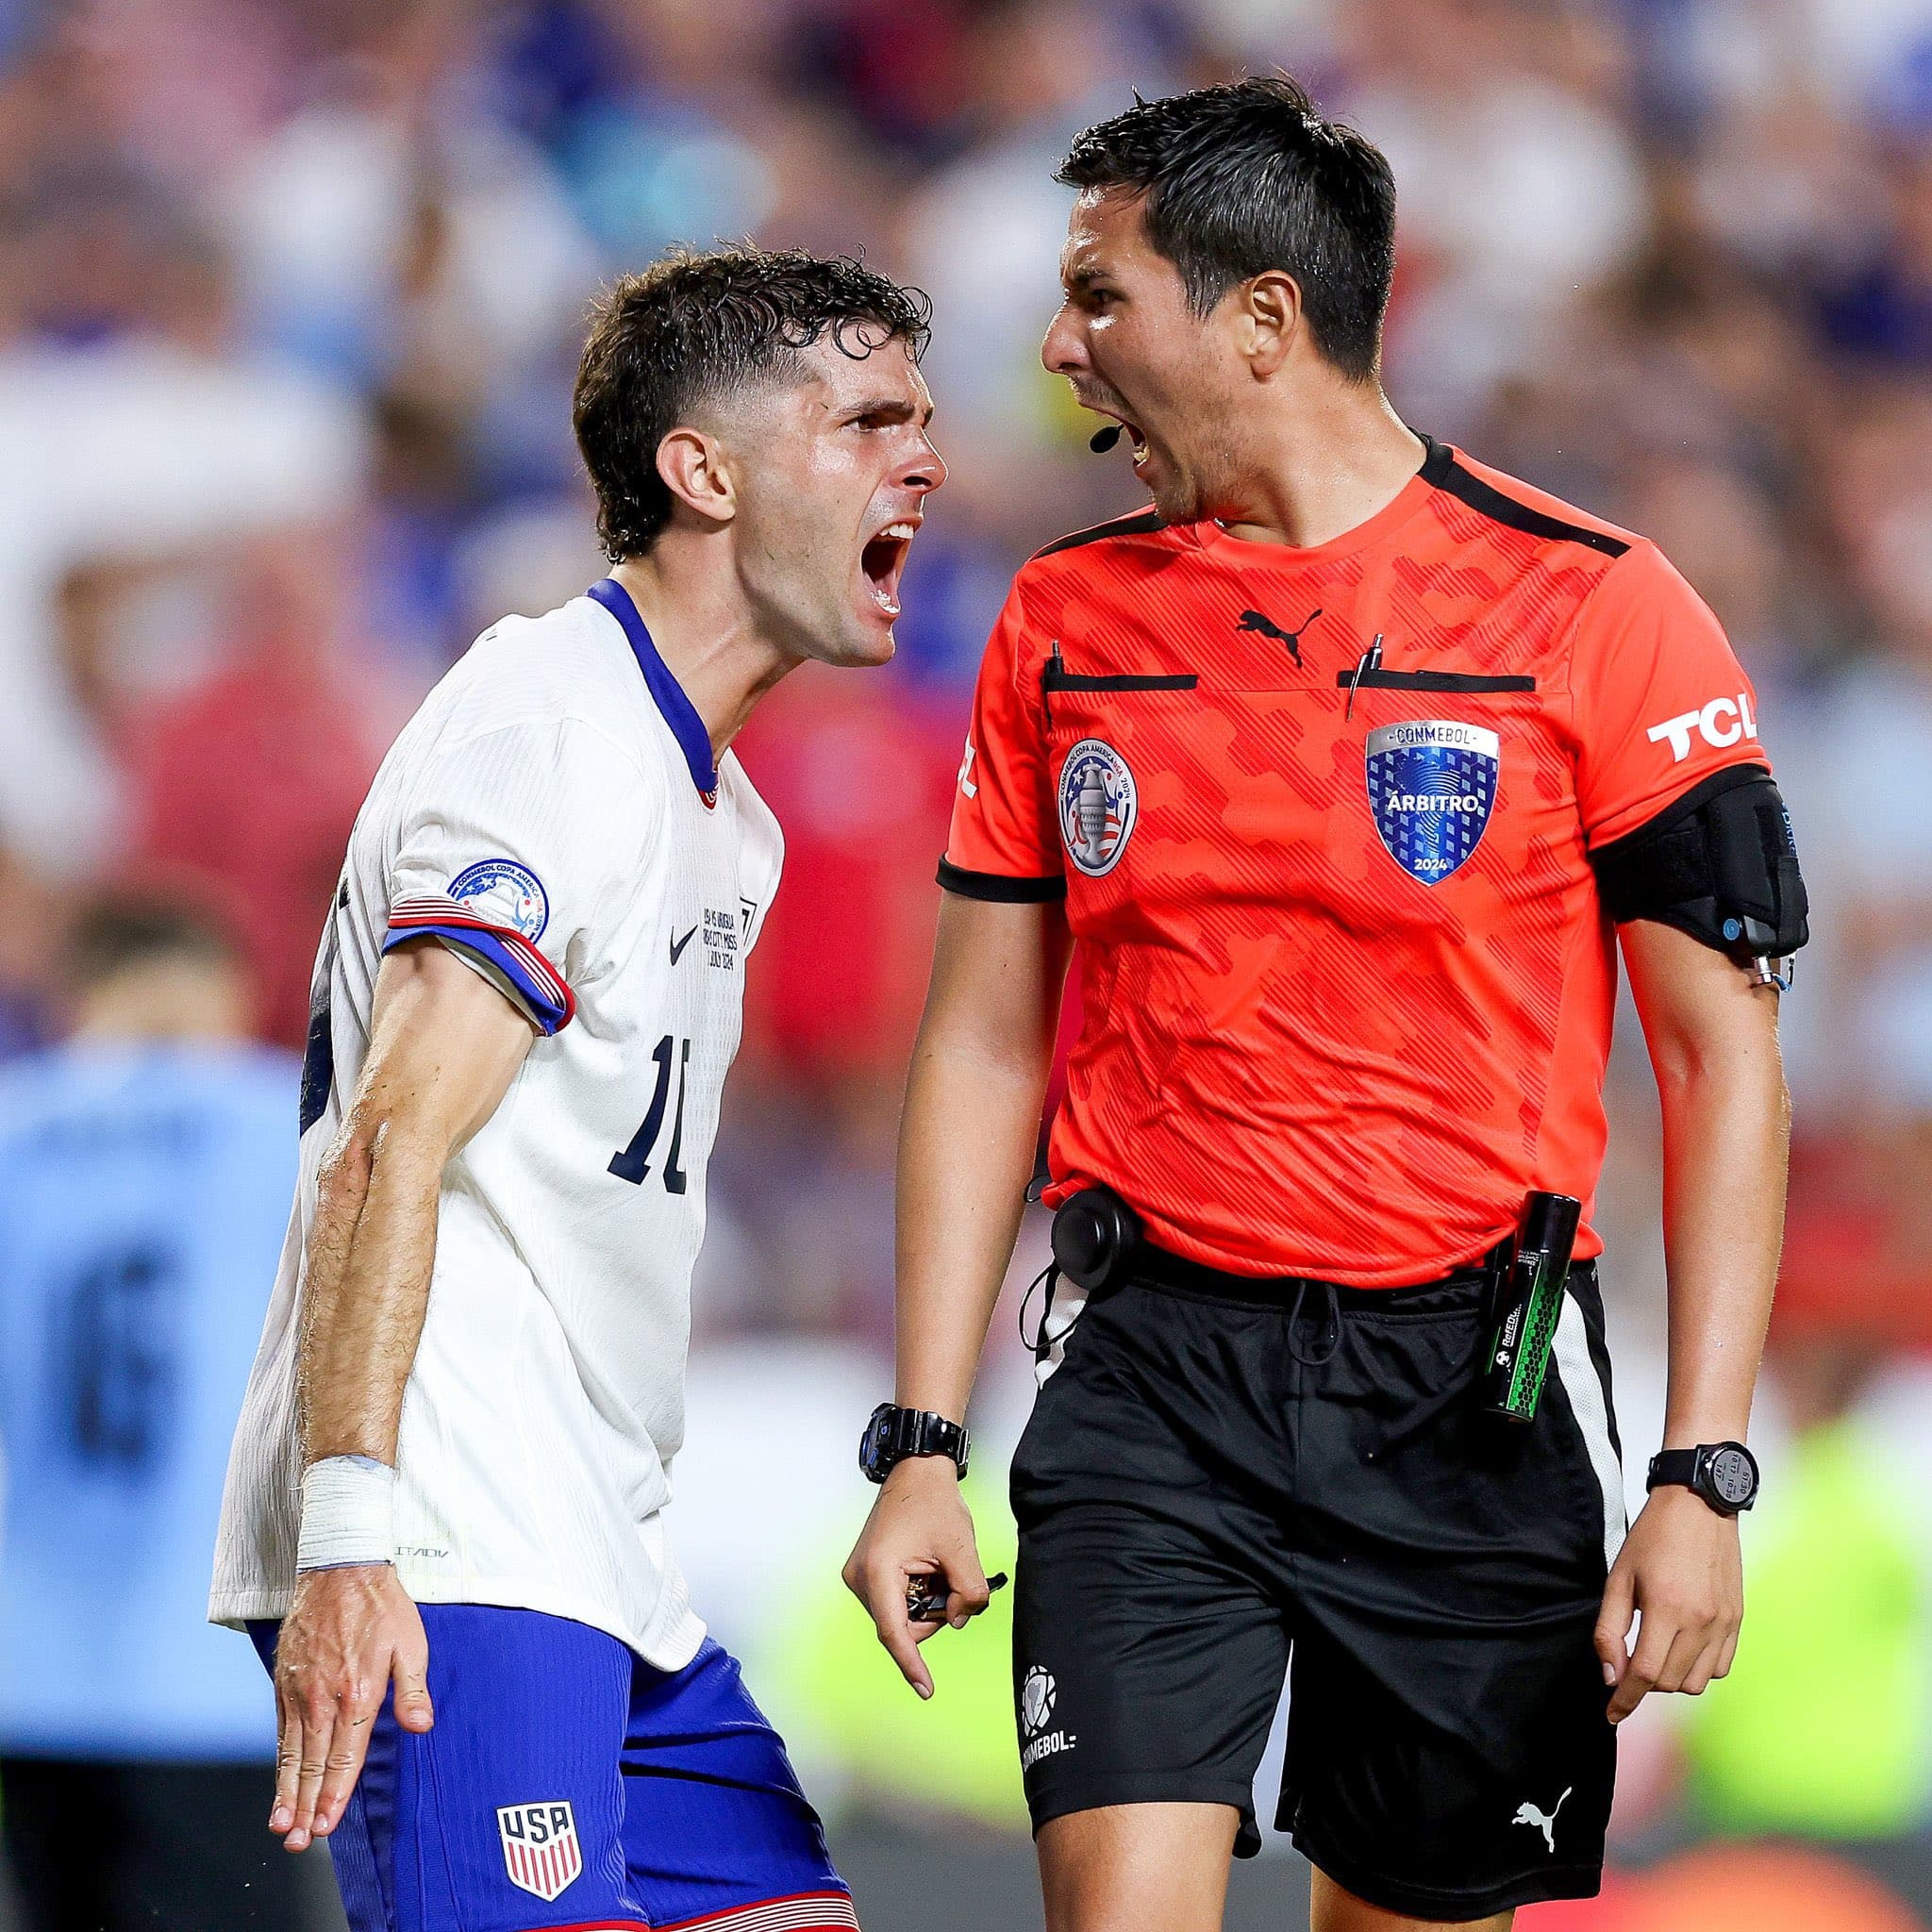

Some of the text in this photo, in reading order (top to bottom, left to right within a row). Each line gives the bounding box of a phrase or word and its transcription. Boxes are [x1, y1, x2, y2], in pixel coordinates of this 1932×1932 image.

[1646, 693, 1757, 762] TCL
[1075, 745, 1090, 758] COPA
[1121, 777, 1131, 799] 2024
[1388, 791, 1479, 812] ÁRBITRO
[1414, 858, 1448, 871] 2024
[503, 1807, 570, 1844] USA
